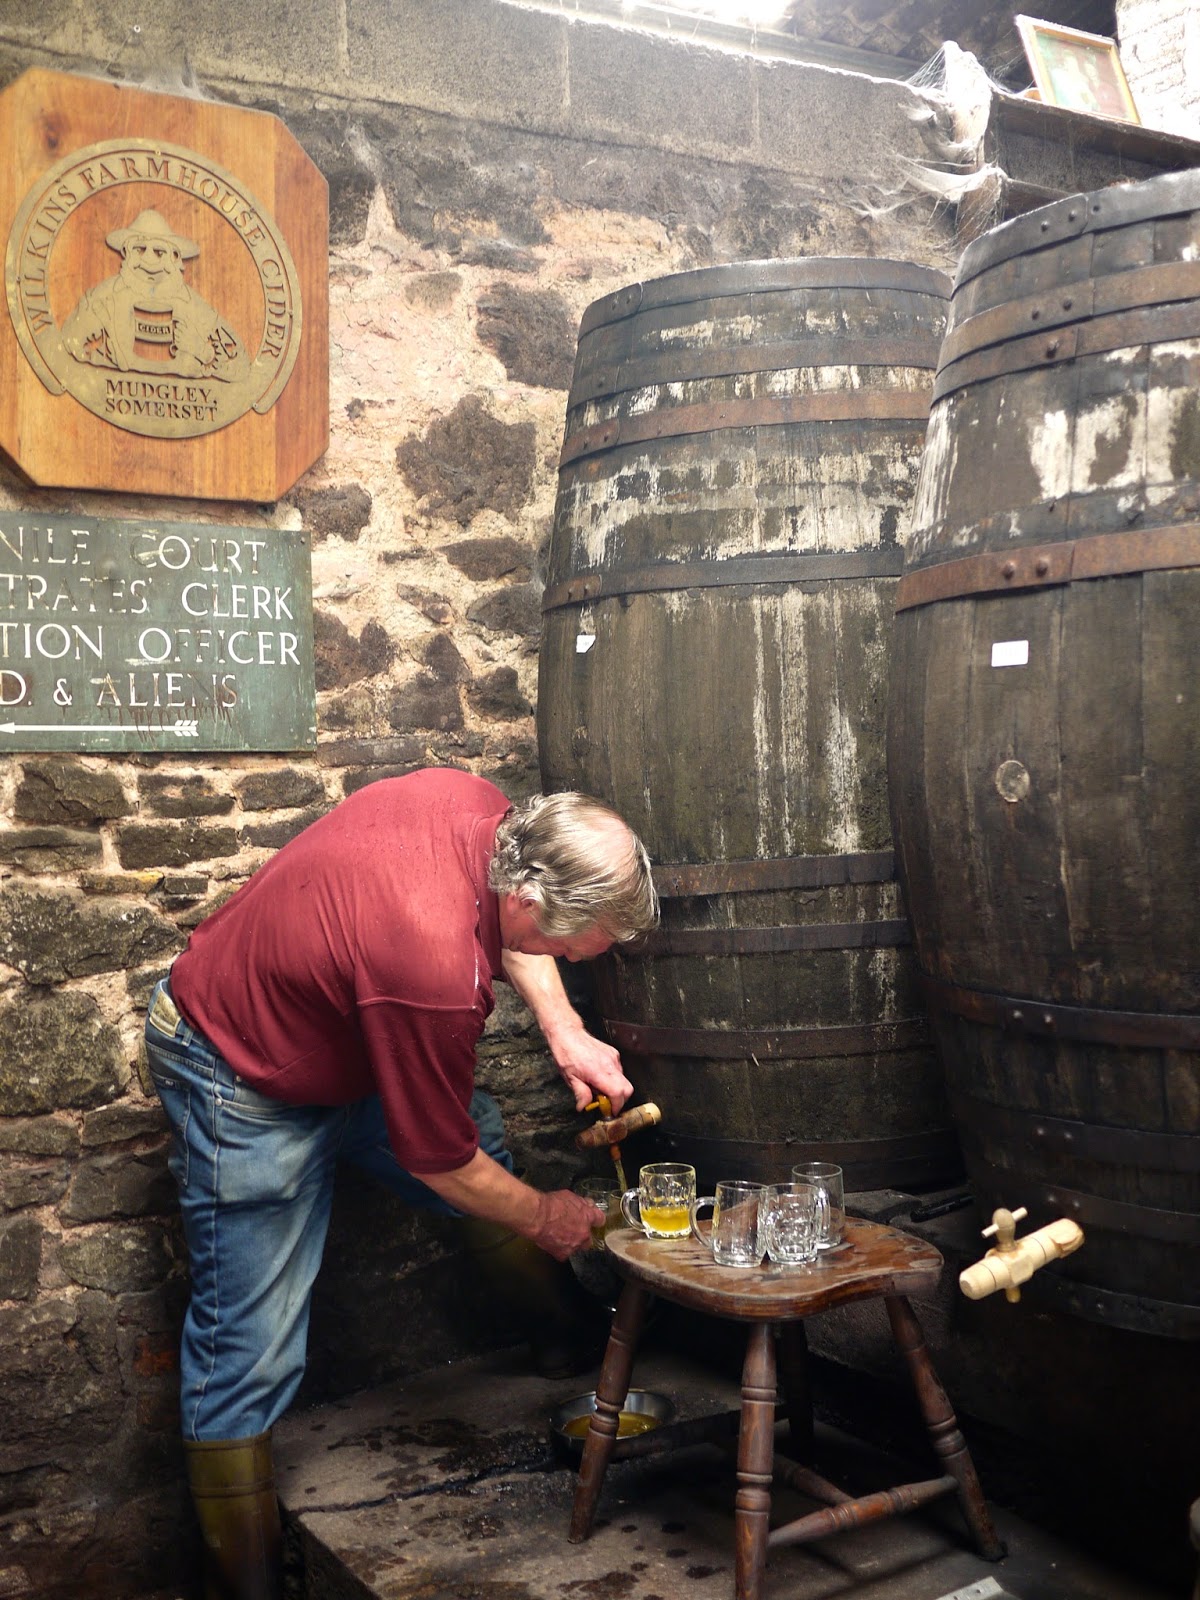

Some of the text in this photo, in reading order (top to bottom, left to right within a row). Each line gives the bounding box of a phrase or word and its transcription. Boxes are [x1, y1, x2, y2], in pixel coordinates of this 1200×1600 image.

[24, 156, 287, 360] WILKINS FARMHOUSE CIDER
[105, 397, 218, 423] SOMERSET
[130, 533, 266, 575] COURT
[181, 582, 294, 620] CLERK
[0, 622, 301, 666] TION OFFICER
[53, 677, 73, 706] &
[96, 672, 238, 708] ALIENS
